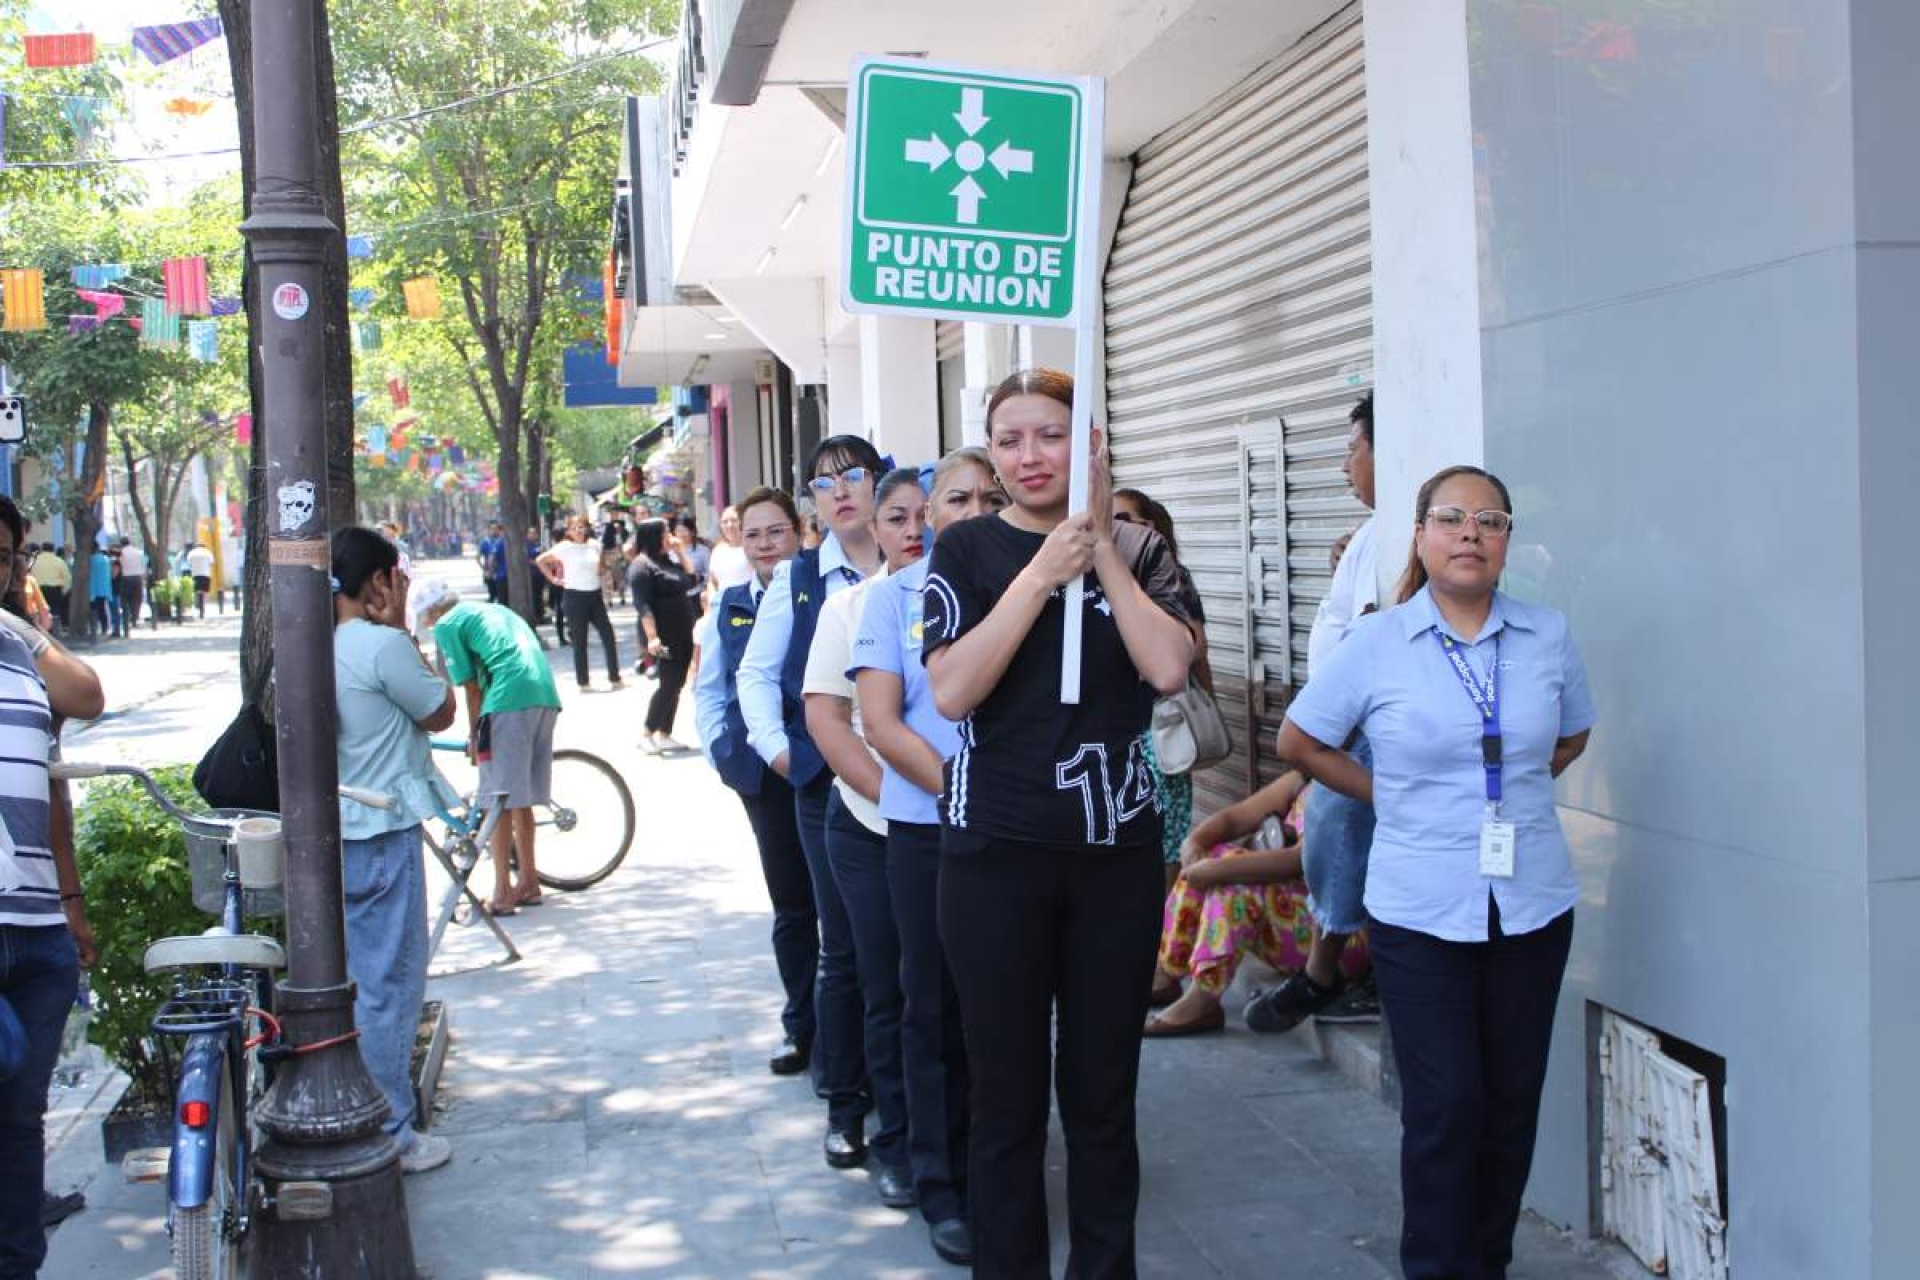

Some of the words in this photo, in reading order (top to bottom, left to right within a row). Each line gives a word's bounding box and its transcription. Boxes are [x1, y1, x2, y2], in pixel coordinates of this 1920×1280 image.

[867, 231, 1001, 272] PUNTO
[1013, 244, 1063, 277] DE
[874, 266, 1051, 309] REUNION
[1055, 738, 1162, 846] 14
